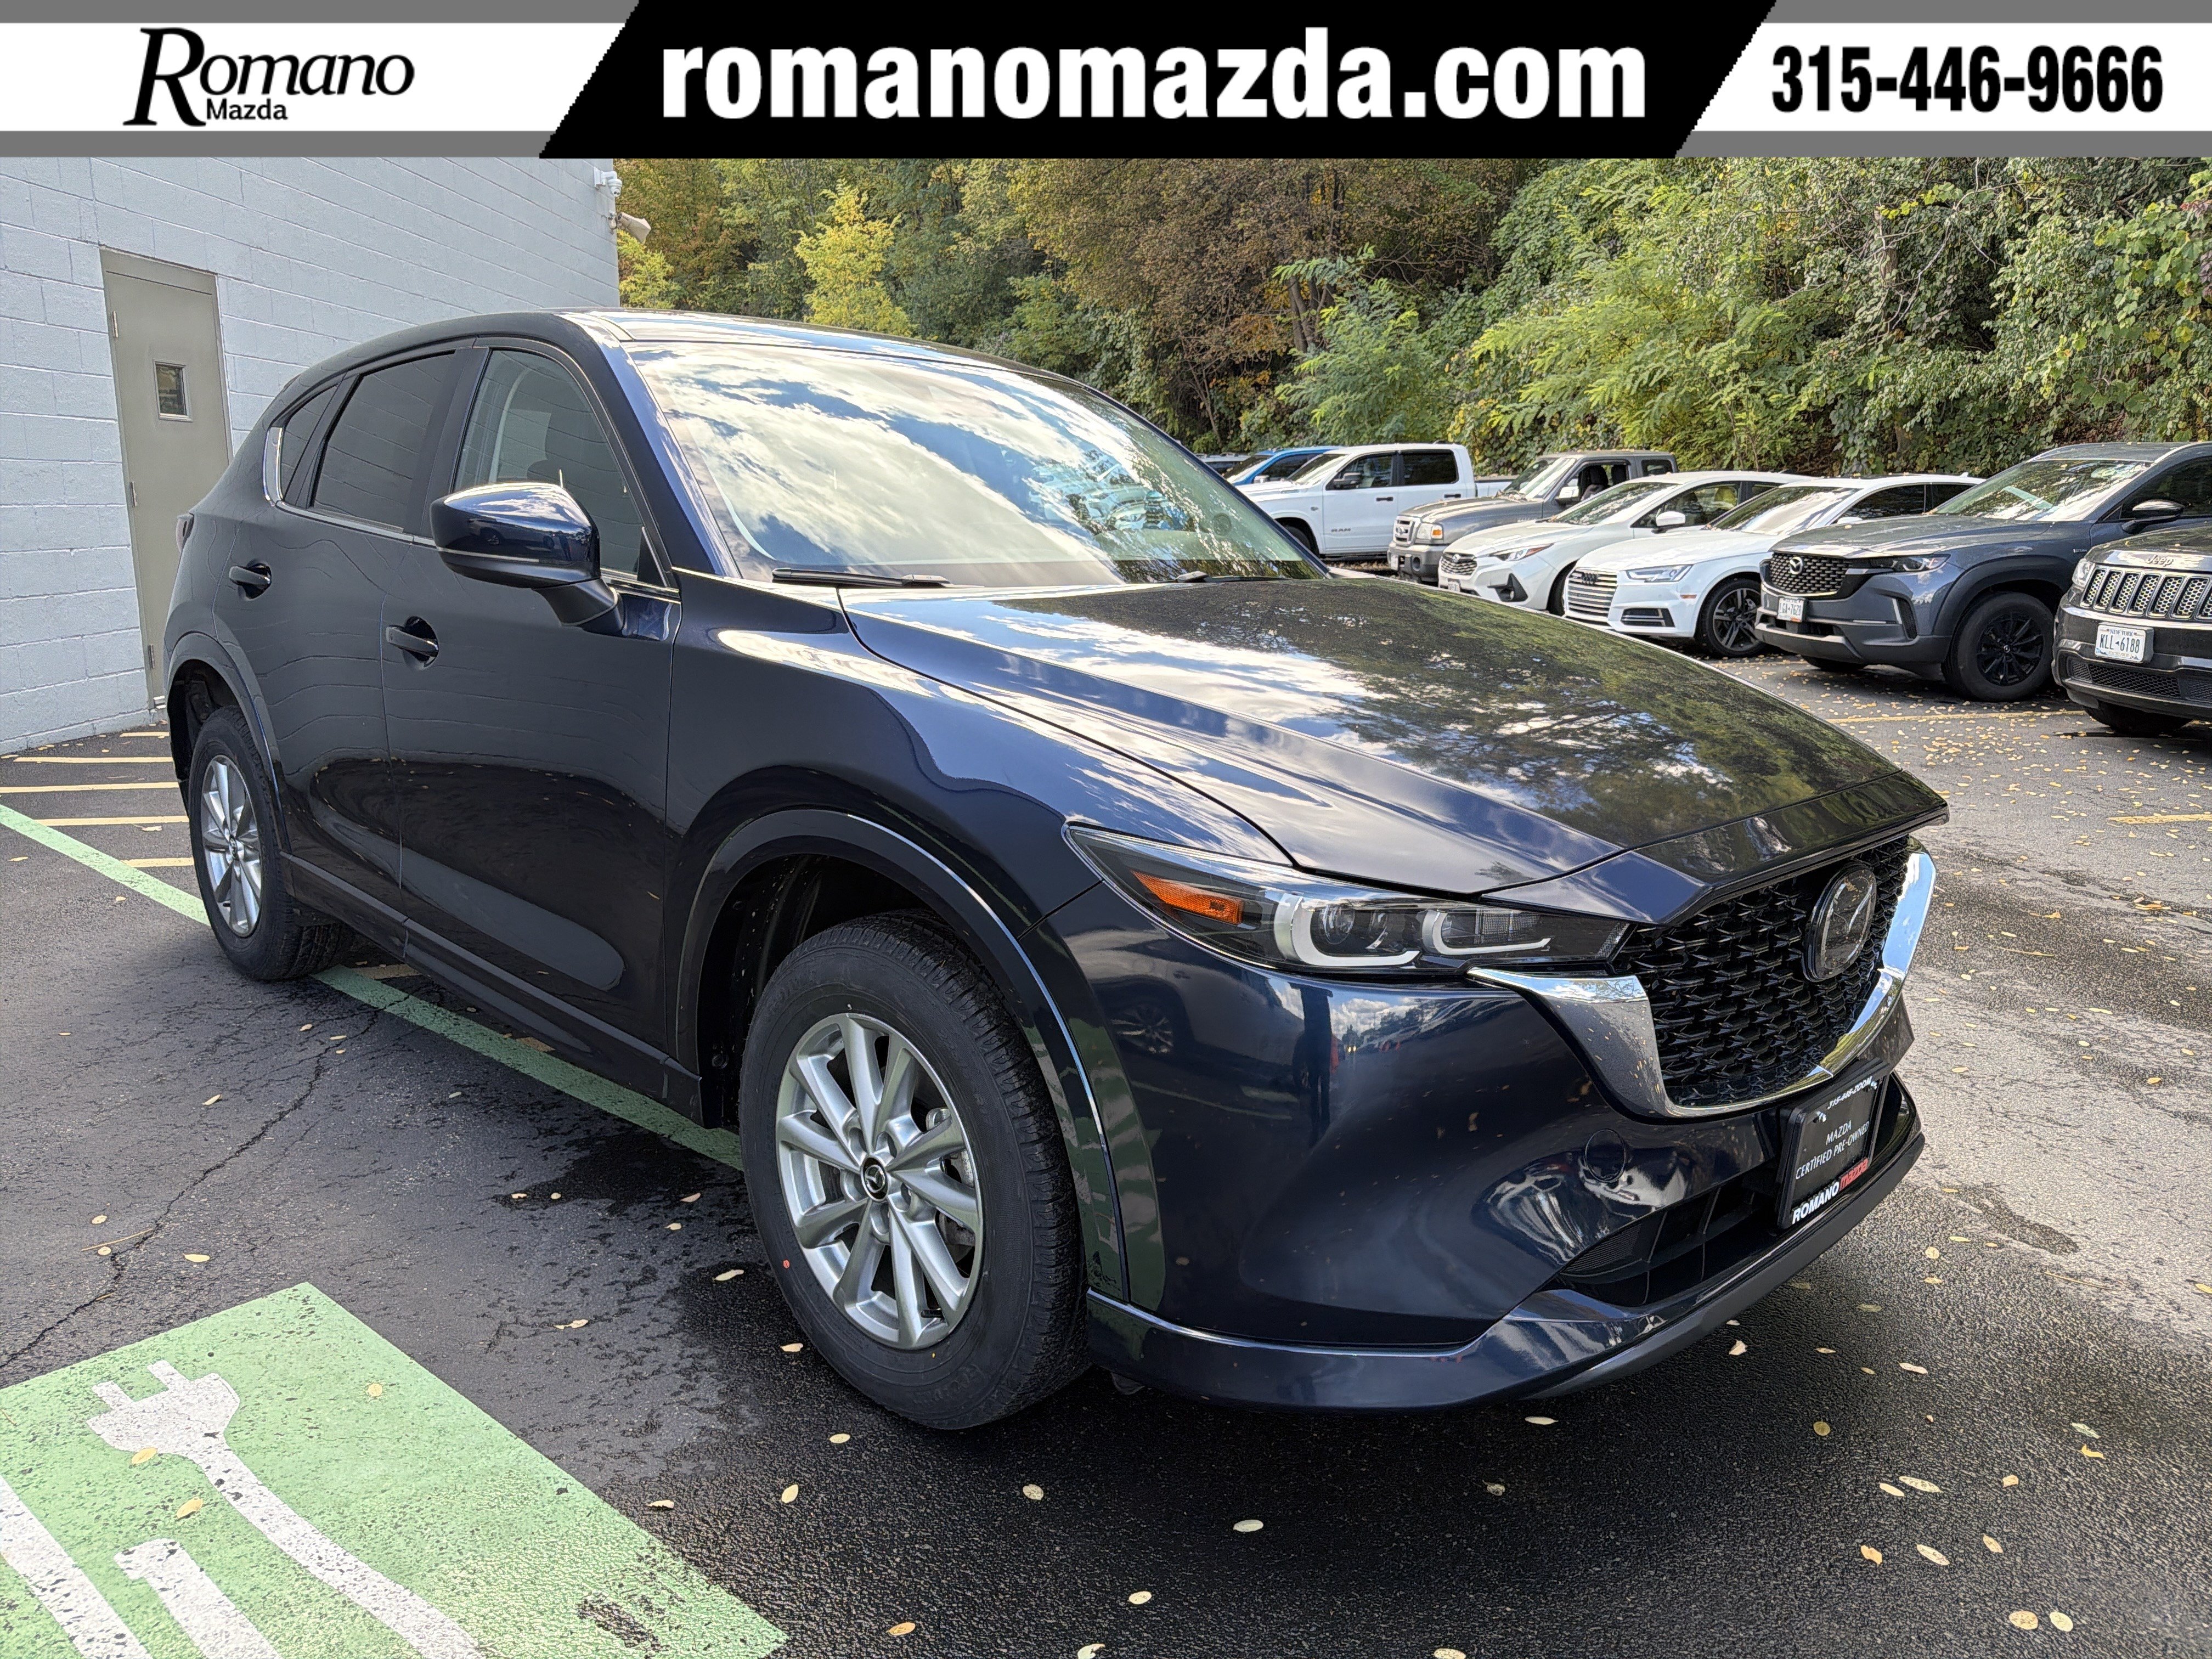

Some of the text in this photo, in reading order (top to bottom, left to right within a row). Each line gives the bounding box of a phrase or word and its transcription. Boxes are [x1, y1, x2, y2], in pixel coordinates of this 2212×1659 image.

[2146, 554, 2174, 567] Jeep
[1826, 1120, 1852, 1146] MAZDA
[1795, 1121, 1870, 1180] CERTIFIED PRE-OWNED
[1792, 1181, 1839, 1224] ROMANO
